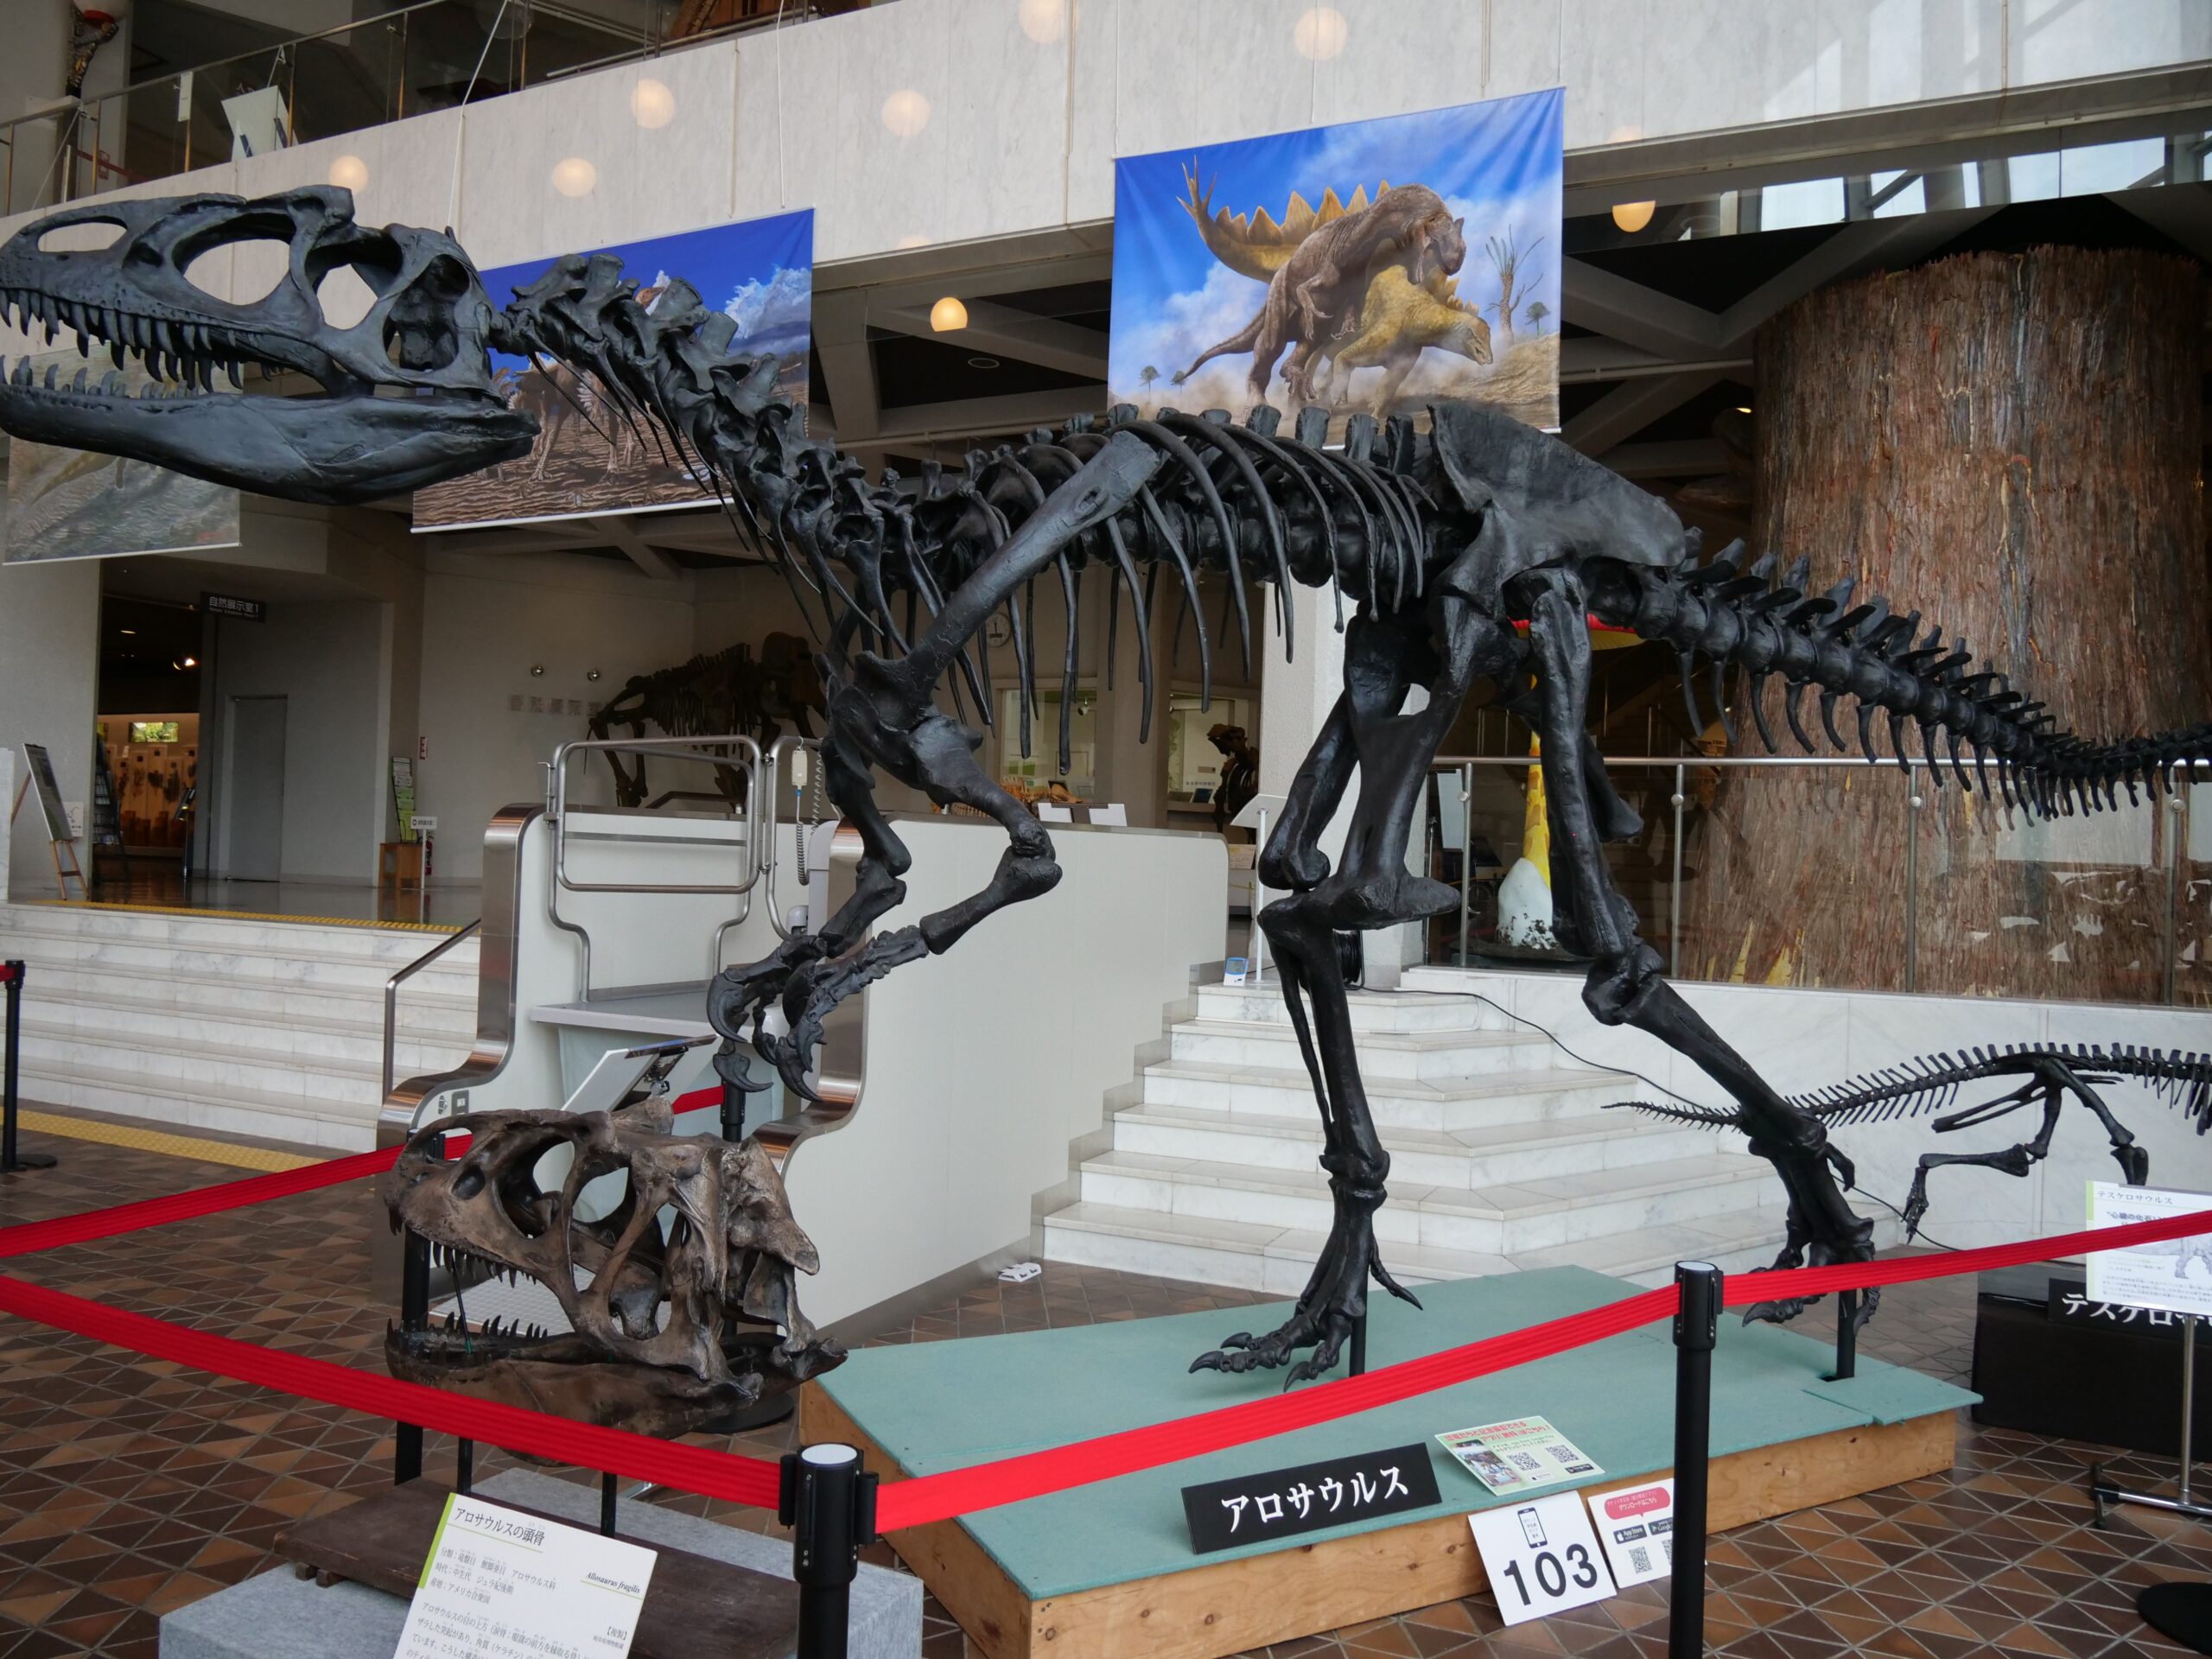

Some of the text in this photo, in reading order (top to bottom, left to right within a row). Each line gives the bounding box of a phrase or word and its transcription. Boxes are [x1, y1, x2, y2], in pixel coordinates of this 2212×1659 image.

[2097, 1189, 2173, 1205] テスケロサウルス
[1221, 1465, 1409, 1533] アロサウルス
[454, 1507, 545, 1547] アロサウルスの頭骨
[512, 1568, 556, 1592] アロサウルス科
[585, 1571, 641, 1594] Allosaurus fragilis
[1503, 1543, 1599, 1606] 103
